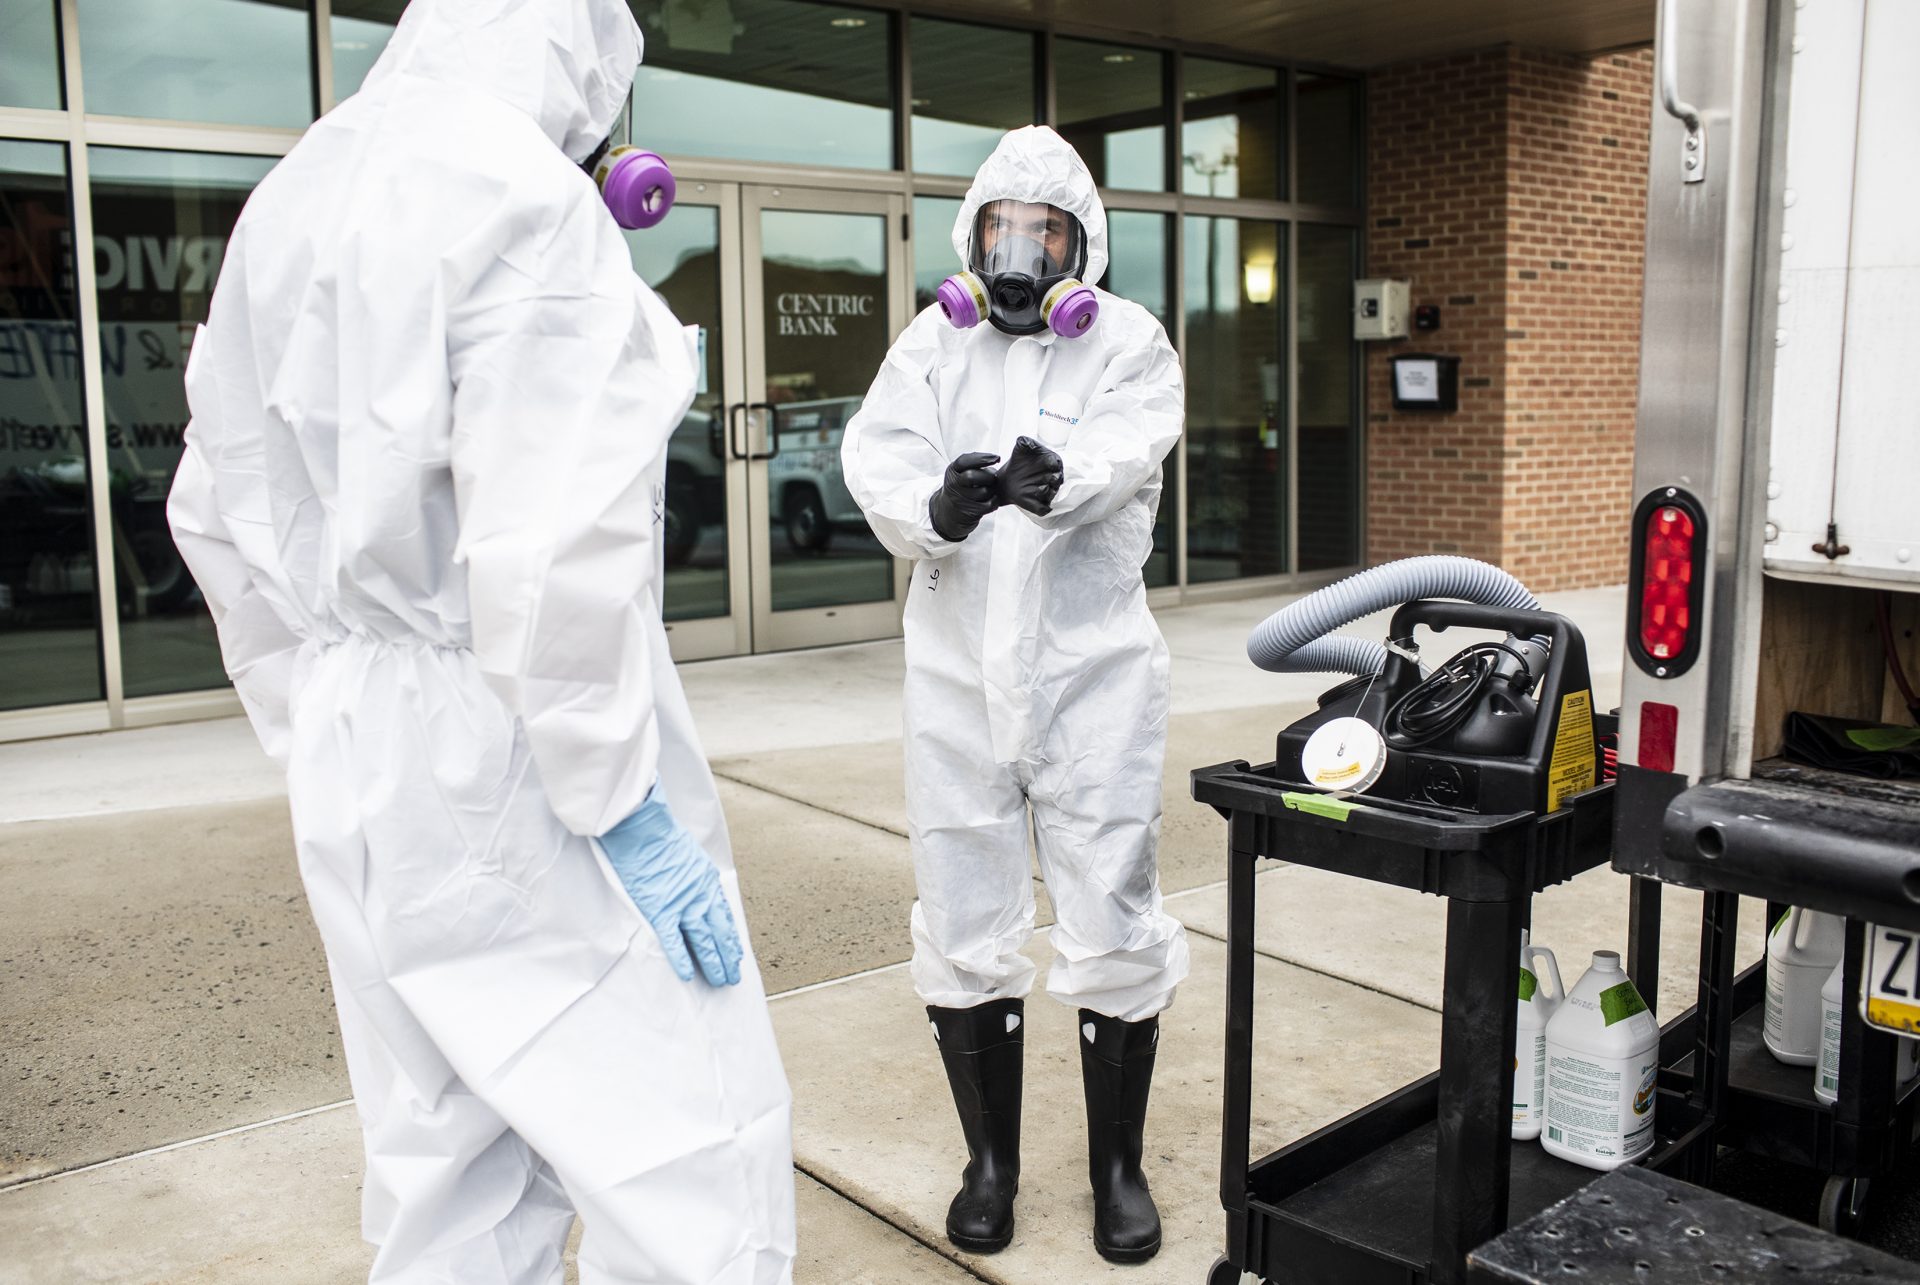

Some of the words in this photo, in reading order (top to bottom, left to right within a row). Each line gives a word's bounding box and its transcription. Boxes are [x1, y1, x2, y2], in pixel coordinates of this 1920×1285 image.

[777, 293, 873, 316] CENTRIC
[779, 316, 838, 336] BANK
[1880, 931, 1920, 1000] Z
